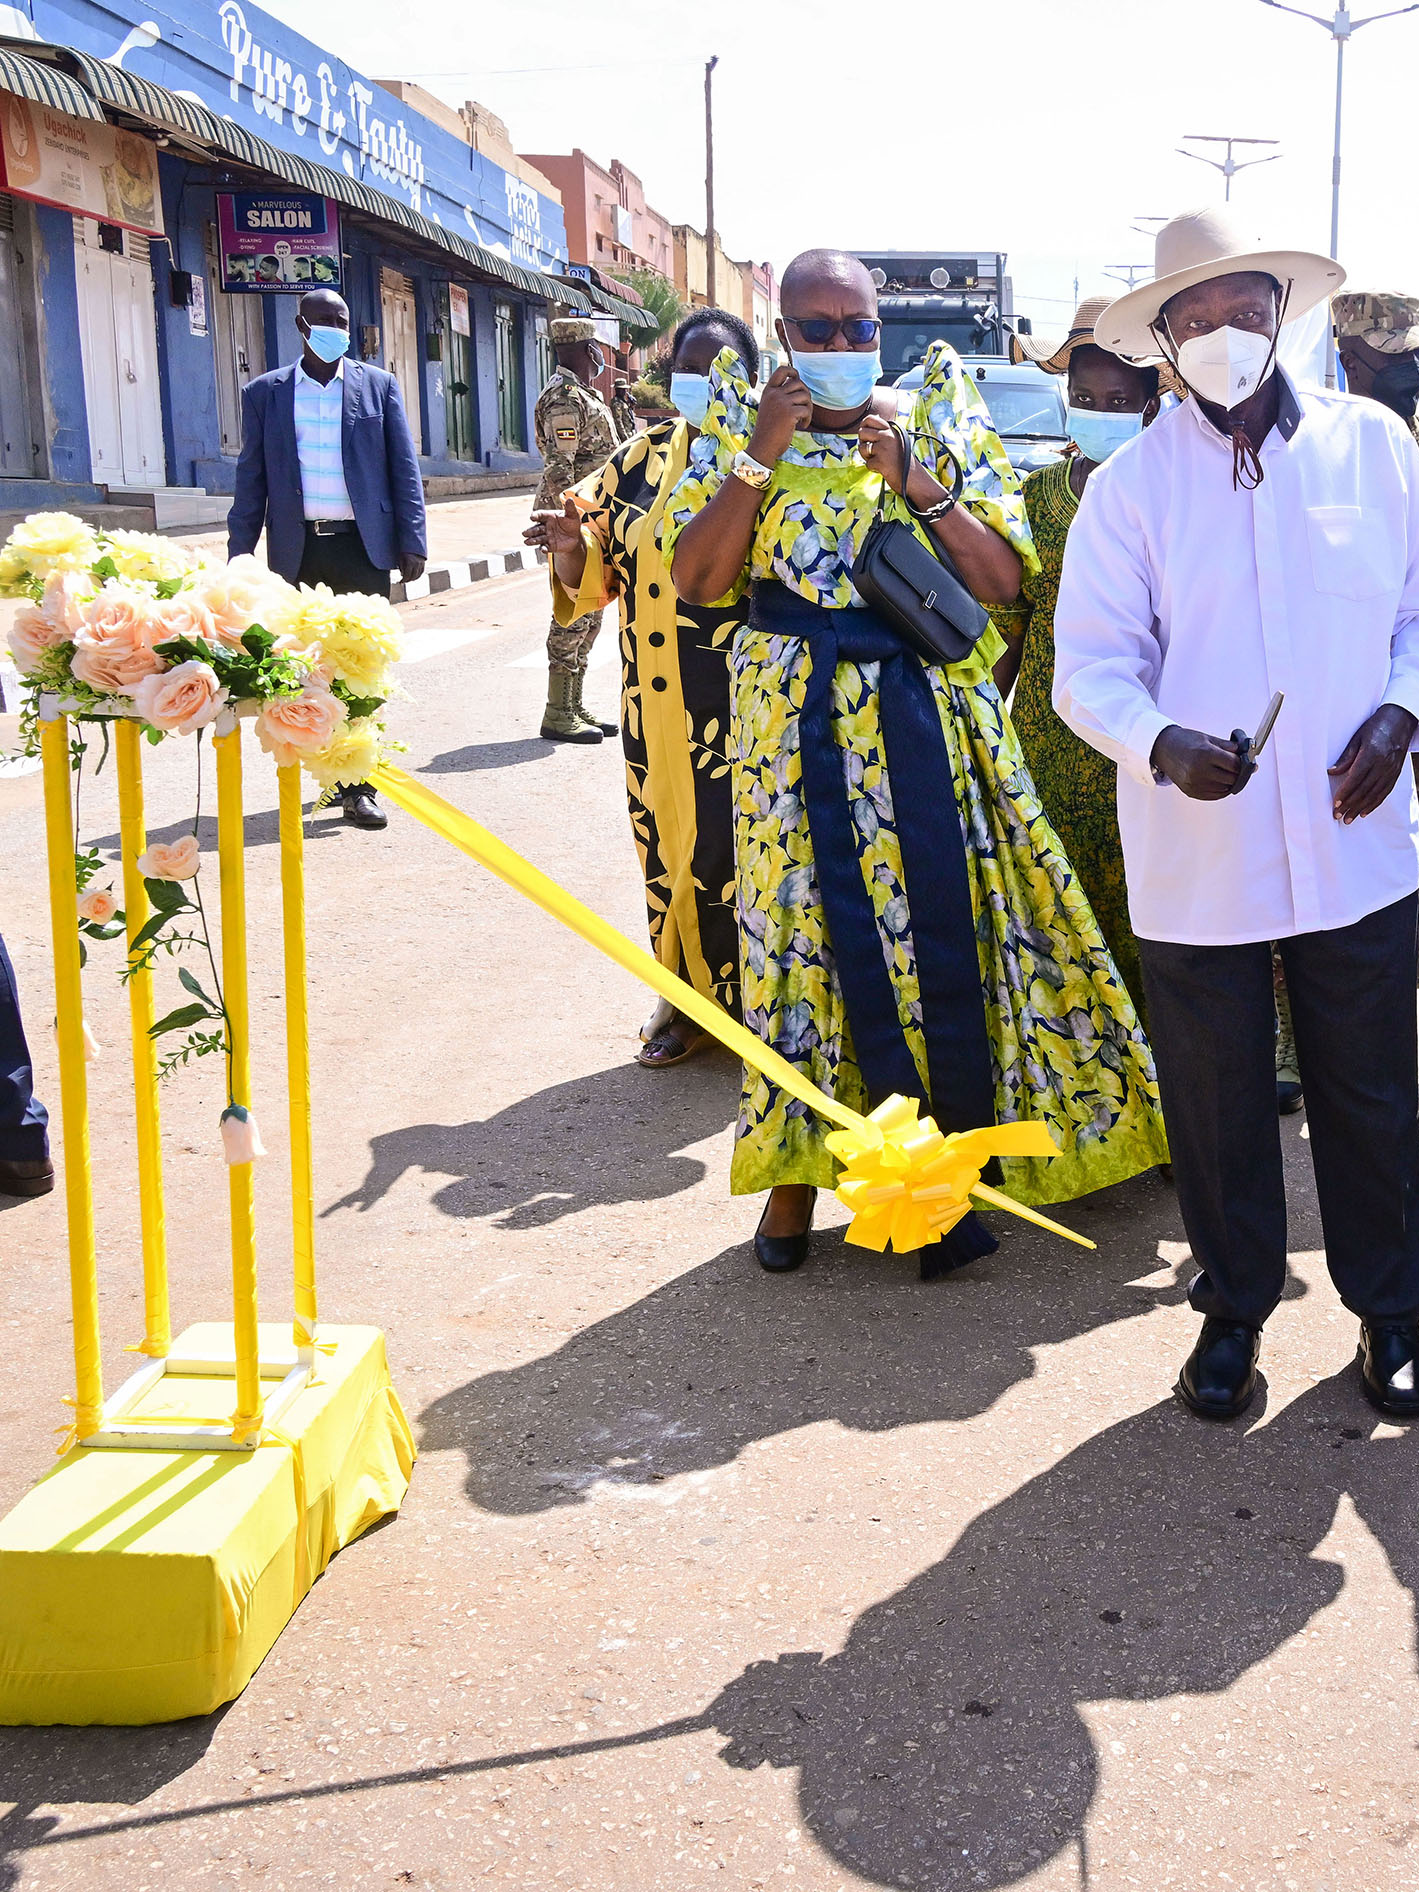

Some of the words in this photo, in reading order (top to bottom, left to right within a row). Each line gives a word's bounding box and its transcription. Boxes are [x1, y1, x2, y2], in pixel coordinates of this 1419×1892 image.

[218, 1, 311, 136] Pure
[317, 62, 346, 156] &
[348, 81, 424, 213] Tasty
[43, 113, 87, 144] Ugachick
[247, 210, 312, 228] SALON
[258, 201, 302, 209] MARVELOUS
[512, 223, 540, 267] MILK
